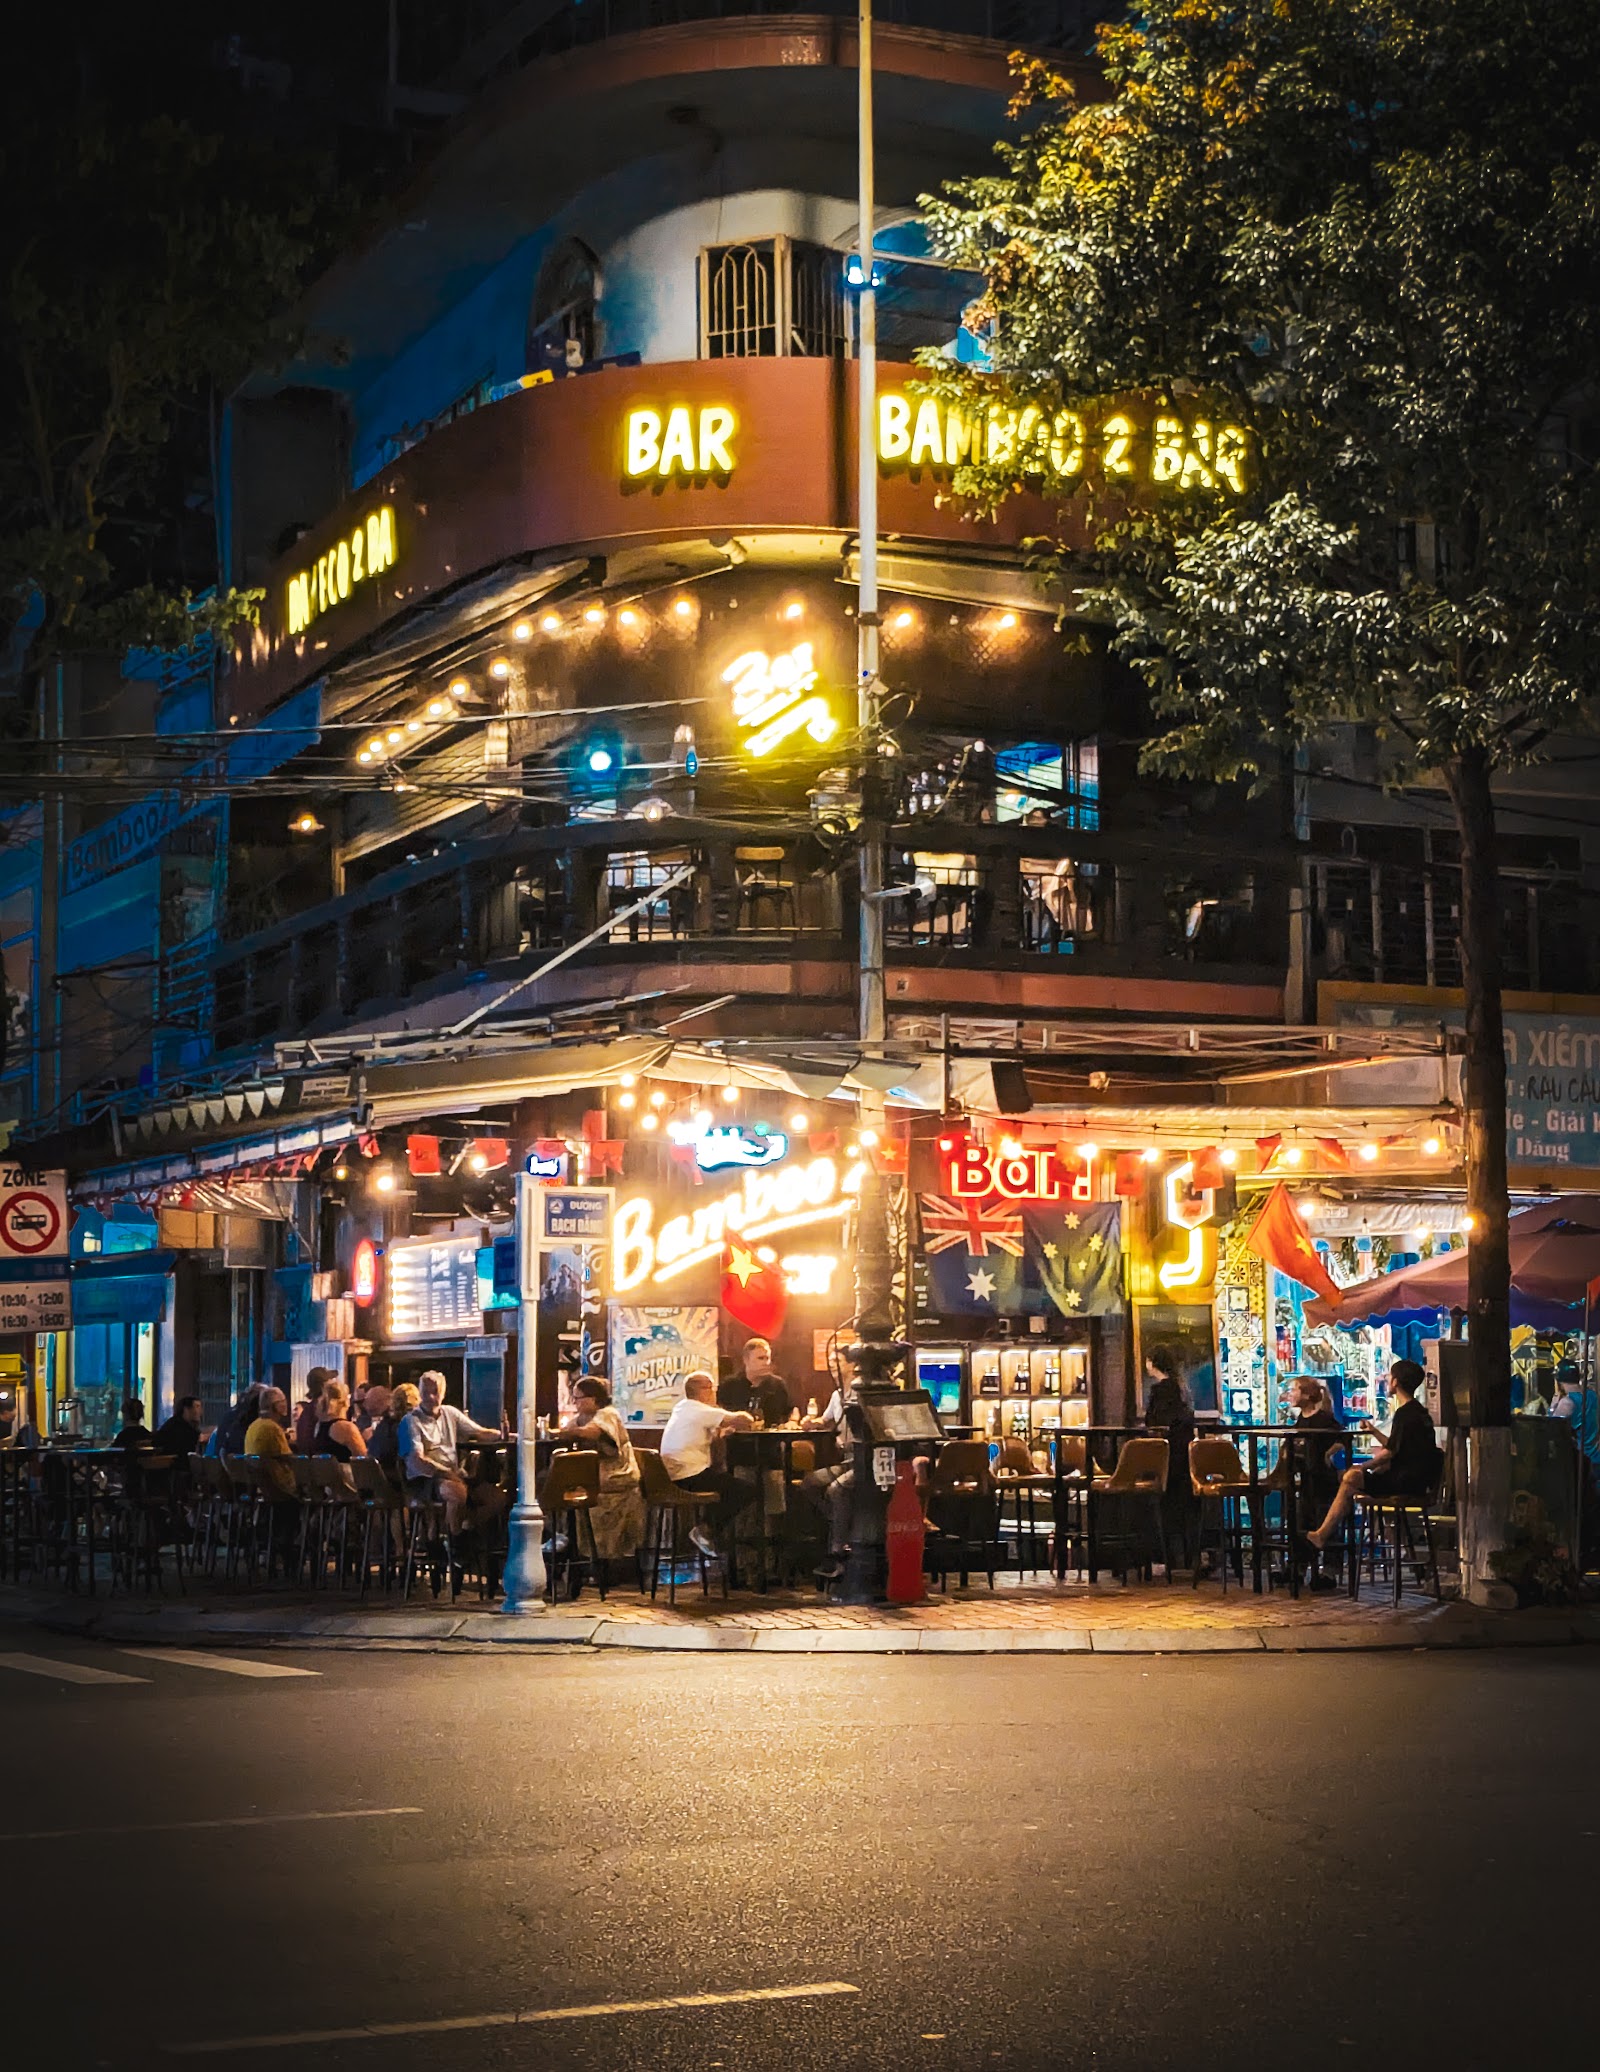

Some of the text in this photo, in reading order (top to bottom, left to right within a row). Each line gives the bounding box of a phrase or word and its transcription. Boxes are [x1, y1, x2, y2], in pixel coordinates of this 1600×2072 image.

[628, 406, 735, 476] BAR
[1103, 416, 1133, 474] 2
[3, 1169, 47, 1188] ZONE
[612, 1157, 837, 1292] Bamboo
[1, 1293, 27, 1307] 10:30
[37, 1291, 64, 1306] 12:00
[626, 1354, 700, 1386] AUSTRALIAN
[645, 1373, 677, 1391] DAY
